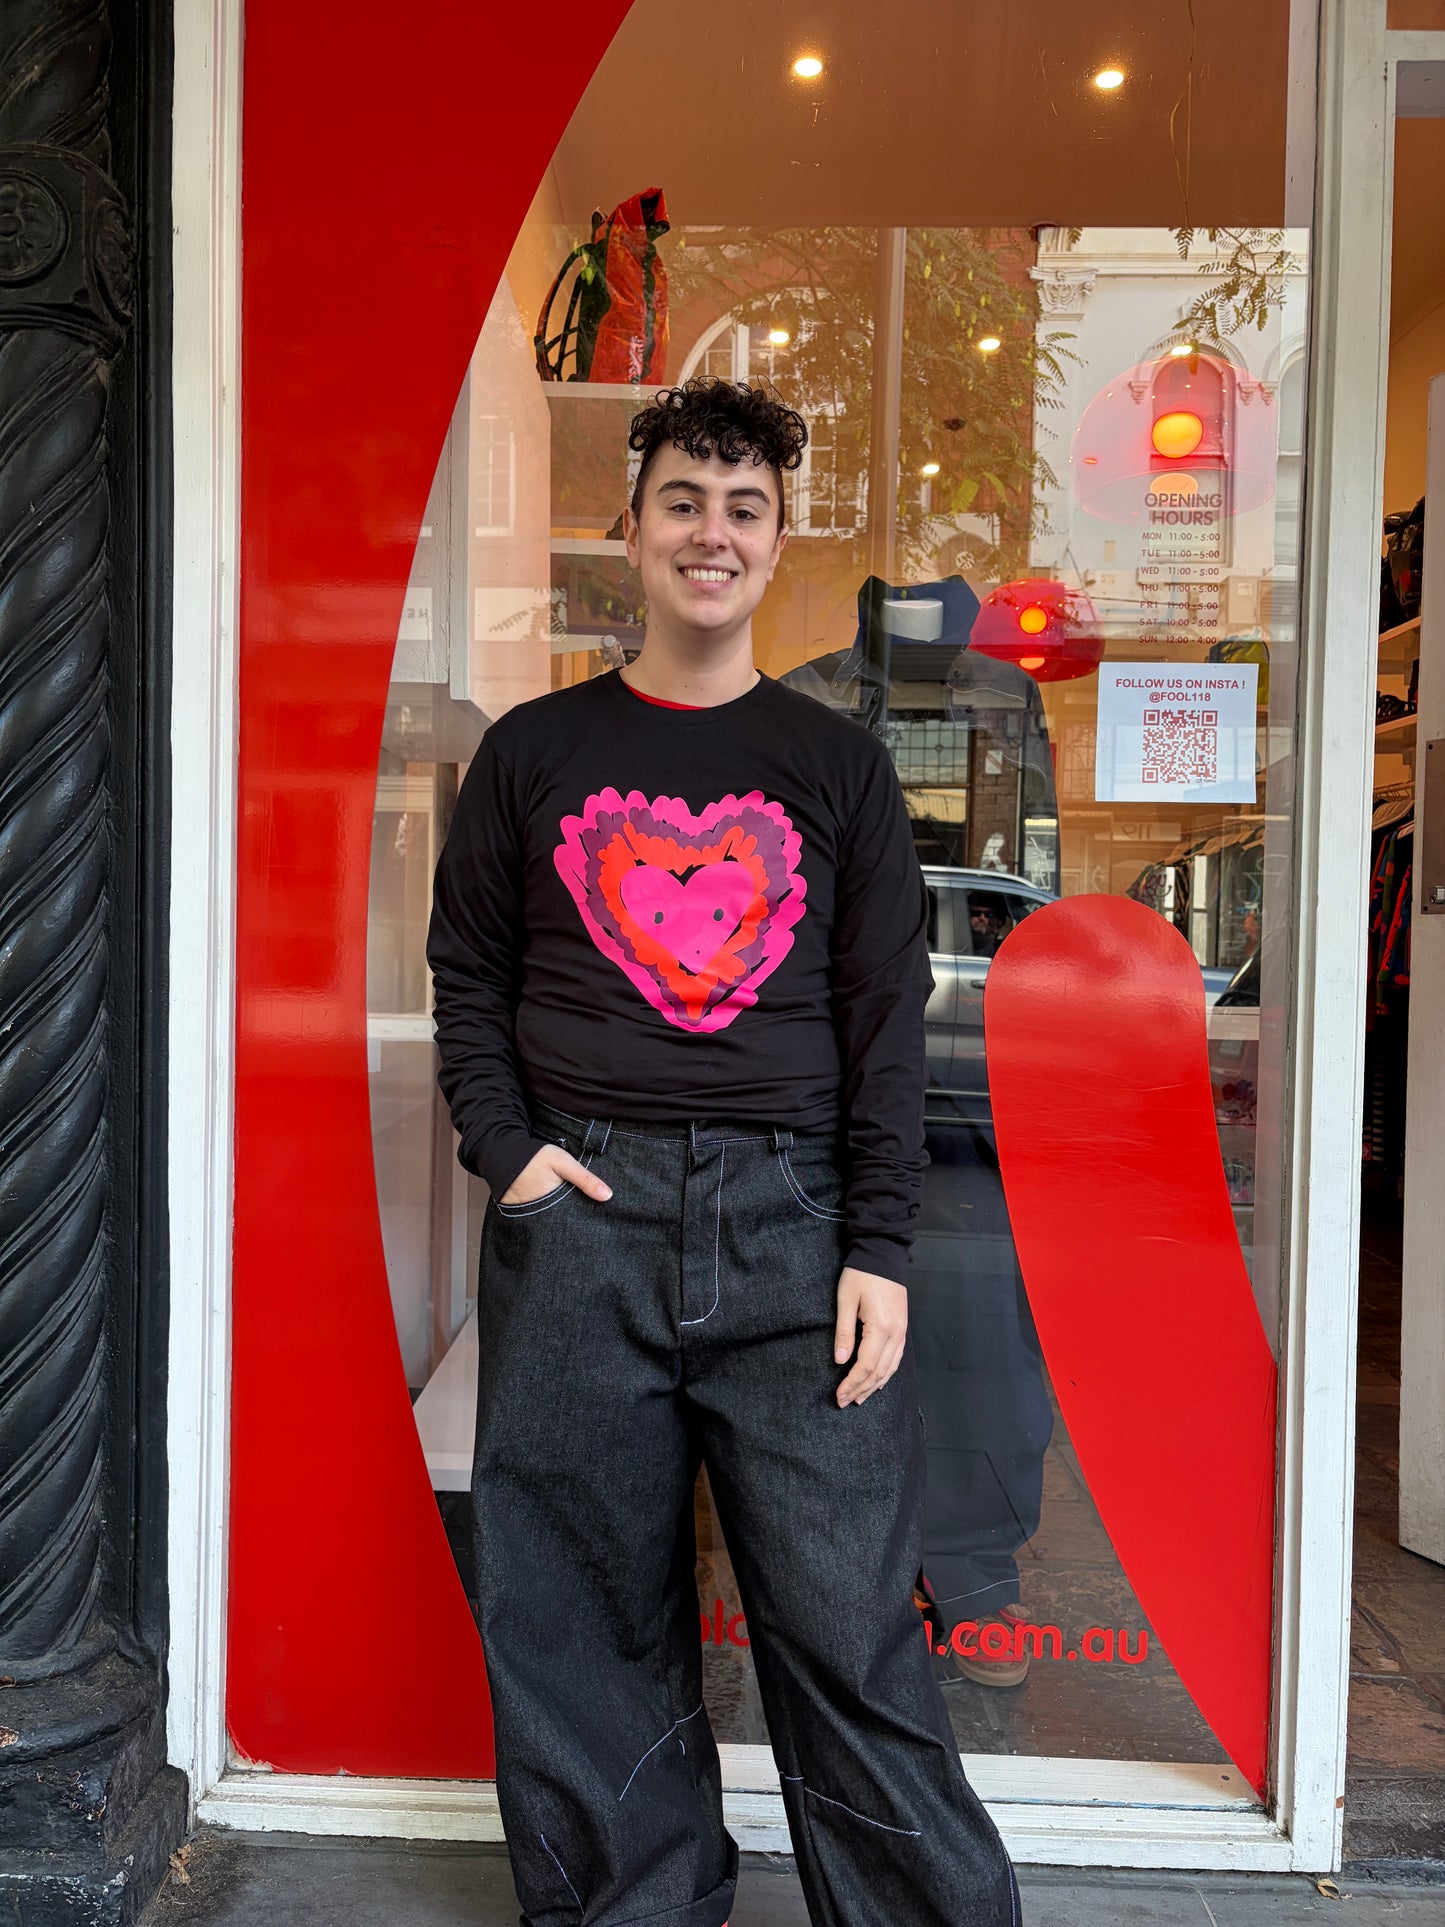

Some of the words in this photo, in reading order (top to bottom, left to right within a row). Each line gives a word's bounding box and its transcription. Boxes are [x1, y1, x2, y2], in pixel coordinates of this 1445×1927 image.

[1144, 493, 1222, 508] OPENING
[1152, 511, 1213, 525] HOURS
[1142, 532, 1162, 540] MON
[1142, 549, 1161, 557] TUE
[1141, 567, 1160, 575] WED
[1140, 584, 1159, 592] THU
[1140, 601, 1158, 609] FRI
[1139, 618, 1158, 626] SAT
[1138, 635, 1157, 643] SUN
[1115, 679, 1164, 689] FOLLOW
[1167, 679, 1182, 689] US
[1185, 680, 1202, 689] ON
[1206, 680, 1238, 689] INSTA
[1149, 692, 1211, 703] @FOOL118
